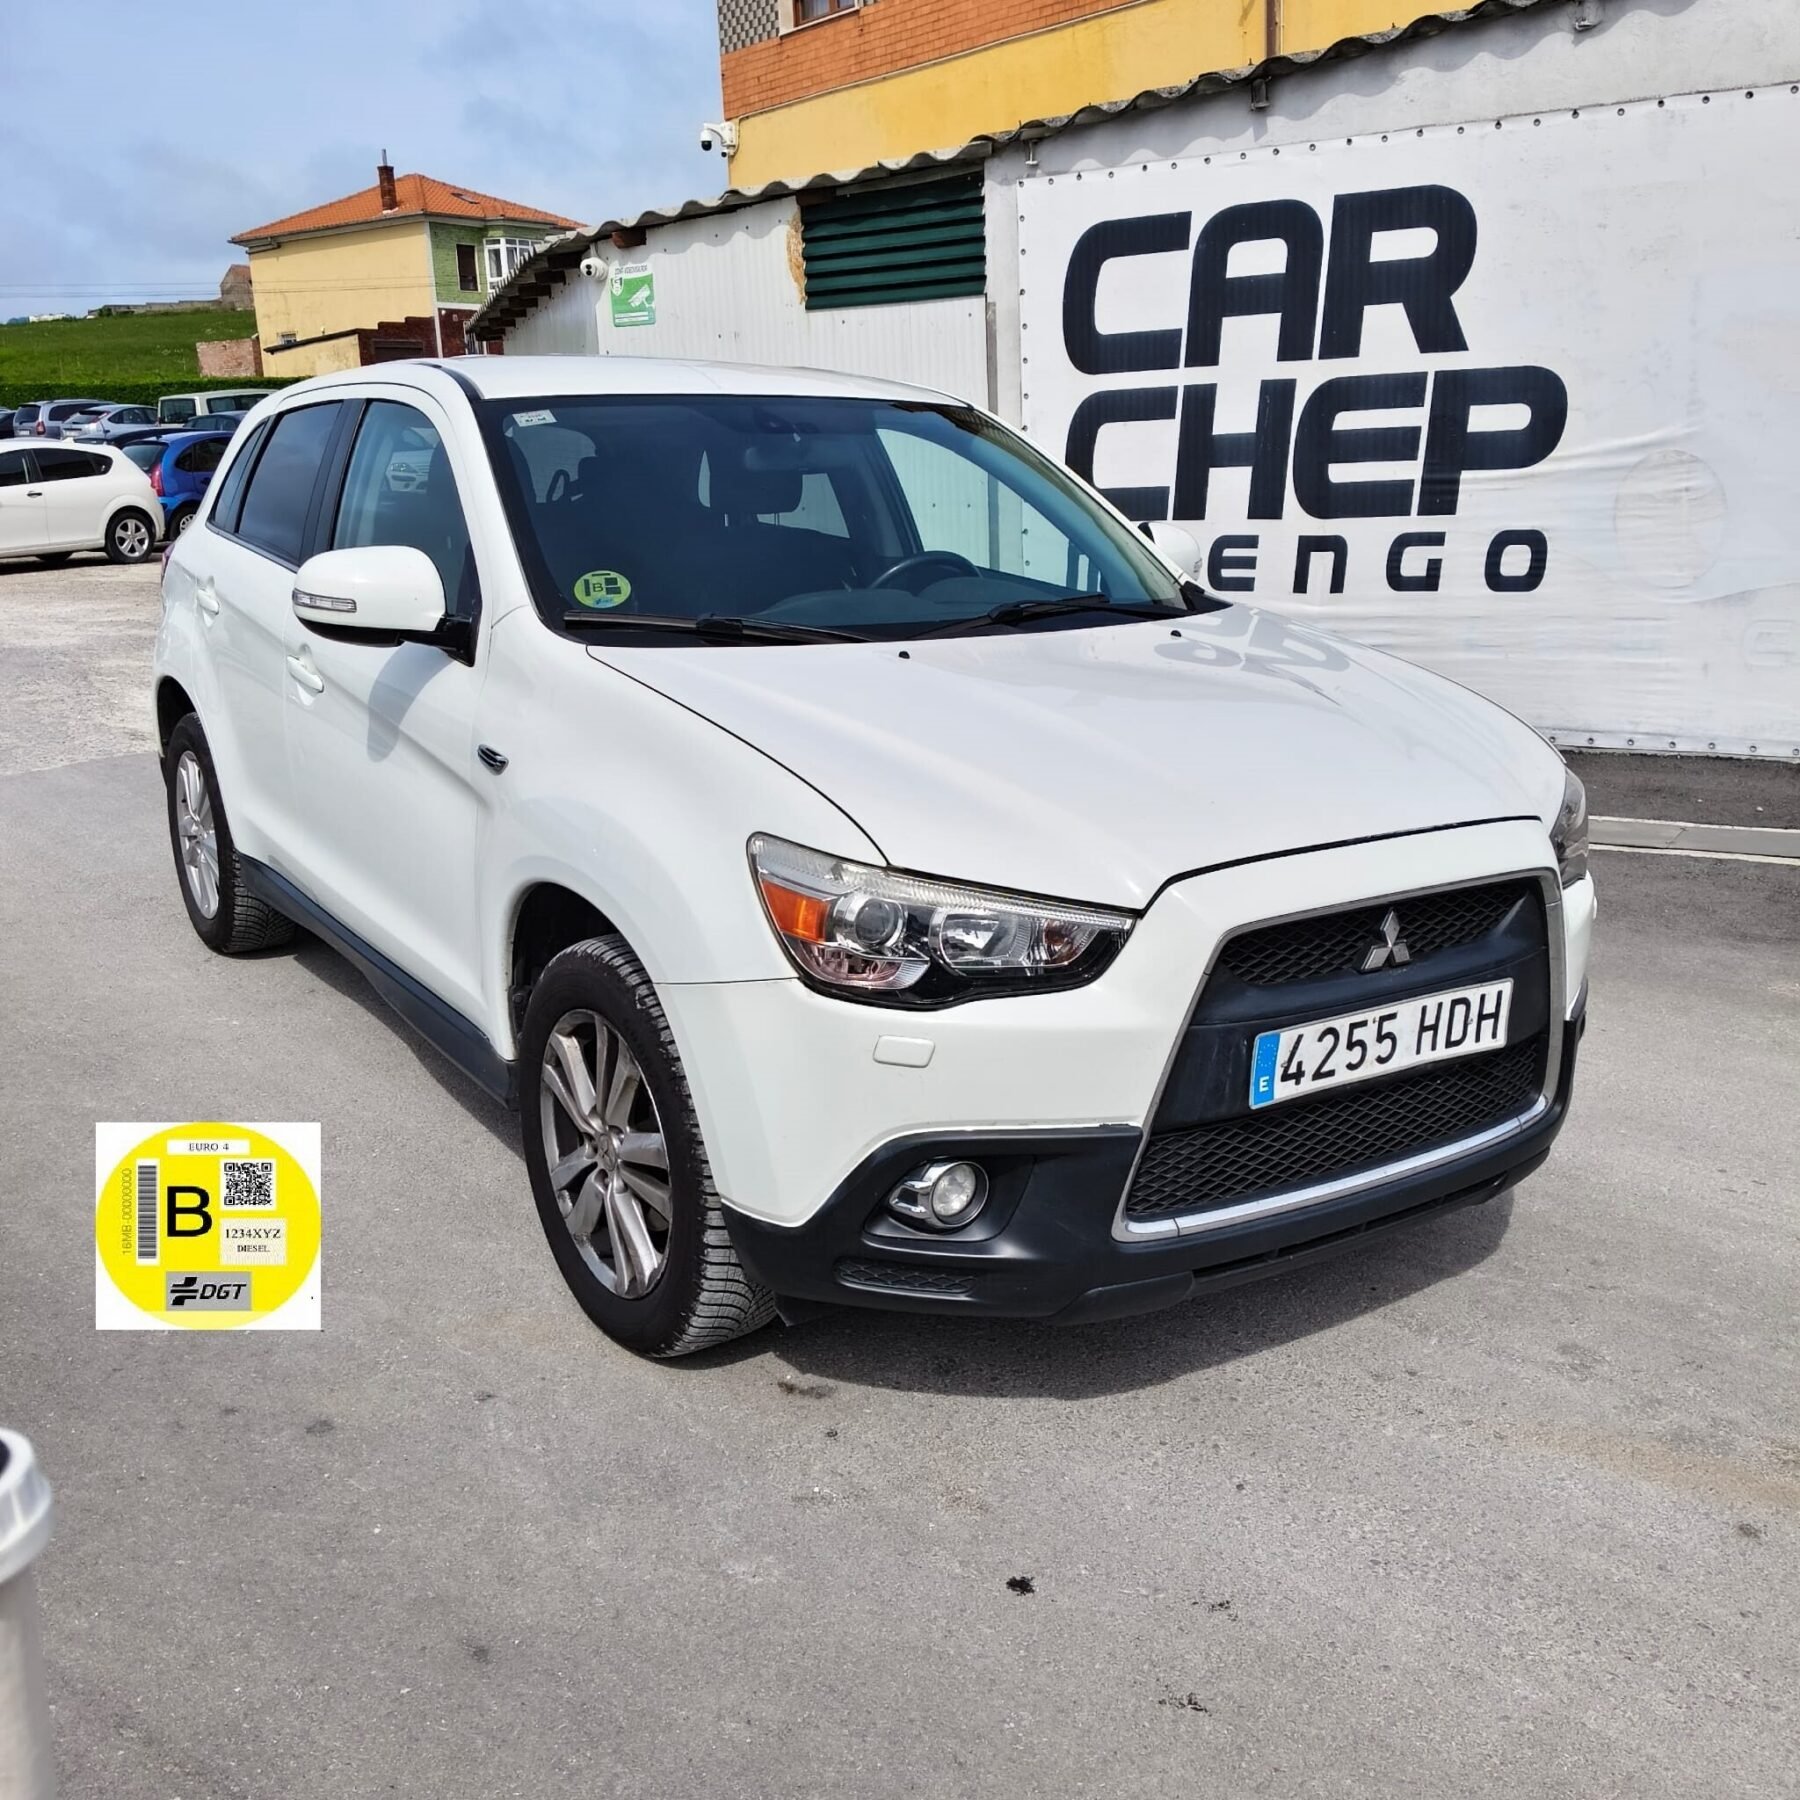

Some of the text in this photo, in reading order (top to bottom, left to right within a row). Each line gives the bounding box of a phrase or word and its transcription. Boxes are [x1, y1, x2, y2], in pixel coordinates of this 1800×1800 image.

[1063, 184, 1478, 376] CAR
[1065, 366, 1568, 521] CHEP
[1258, 1075, 1270, 1093] E
[1280, 989, 1503, 1086] 4255 HDH
